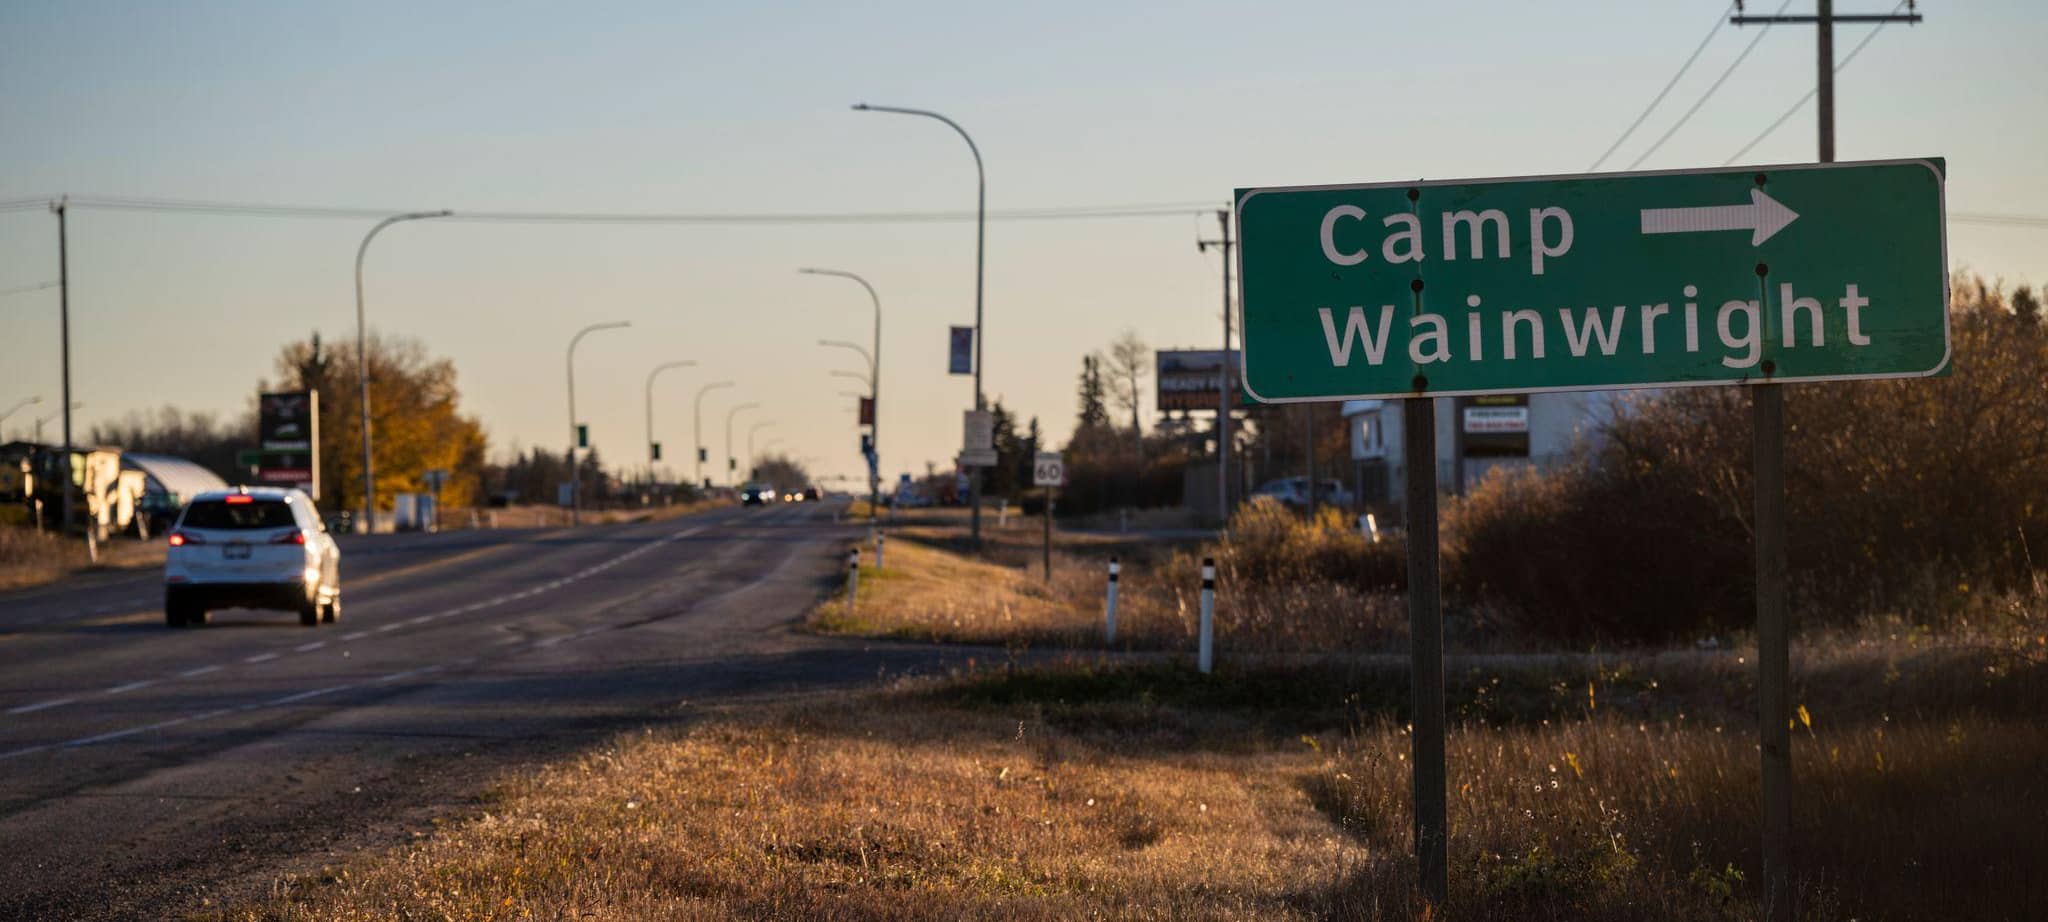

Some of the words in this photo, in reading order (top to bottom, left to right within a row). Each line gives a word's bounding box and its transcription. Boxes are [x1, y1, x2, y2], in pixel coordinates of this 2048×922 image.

[1320, 204, 1575, 275] Camp
[1318, 282, 1871, 369] Wainwright
[1037, 463, 1060, 480] 60
